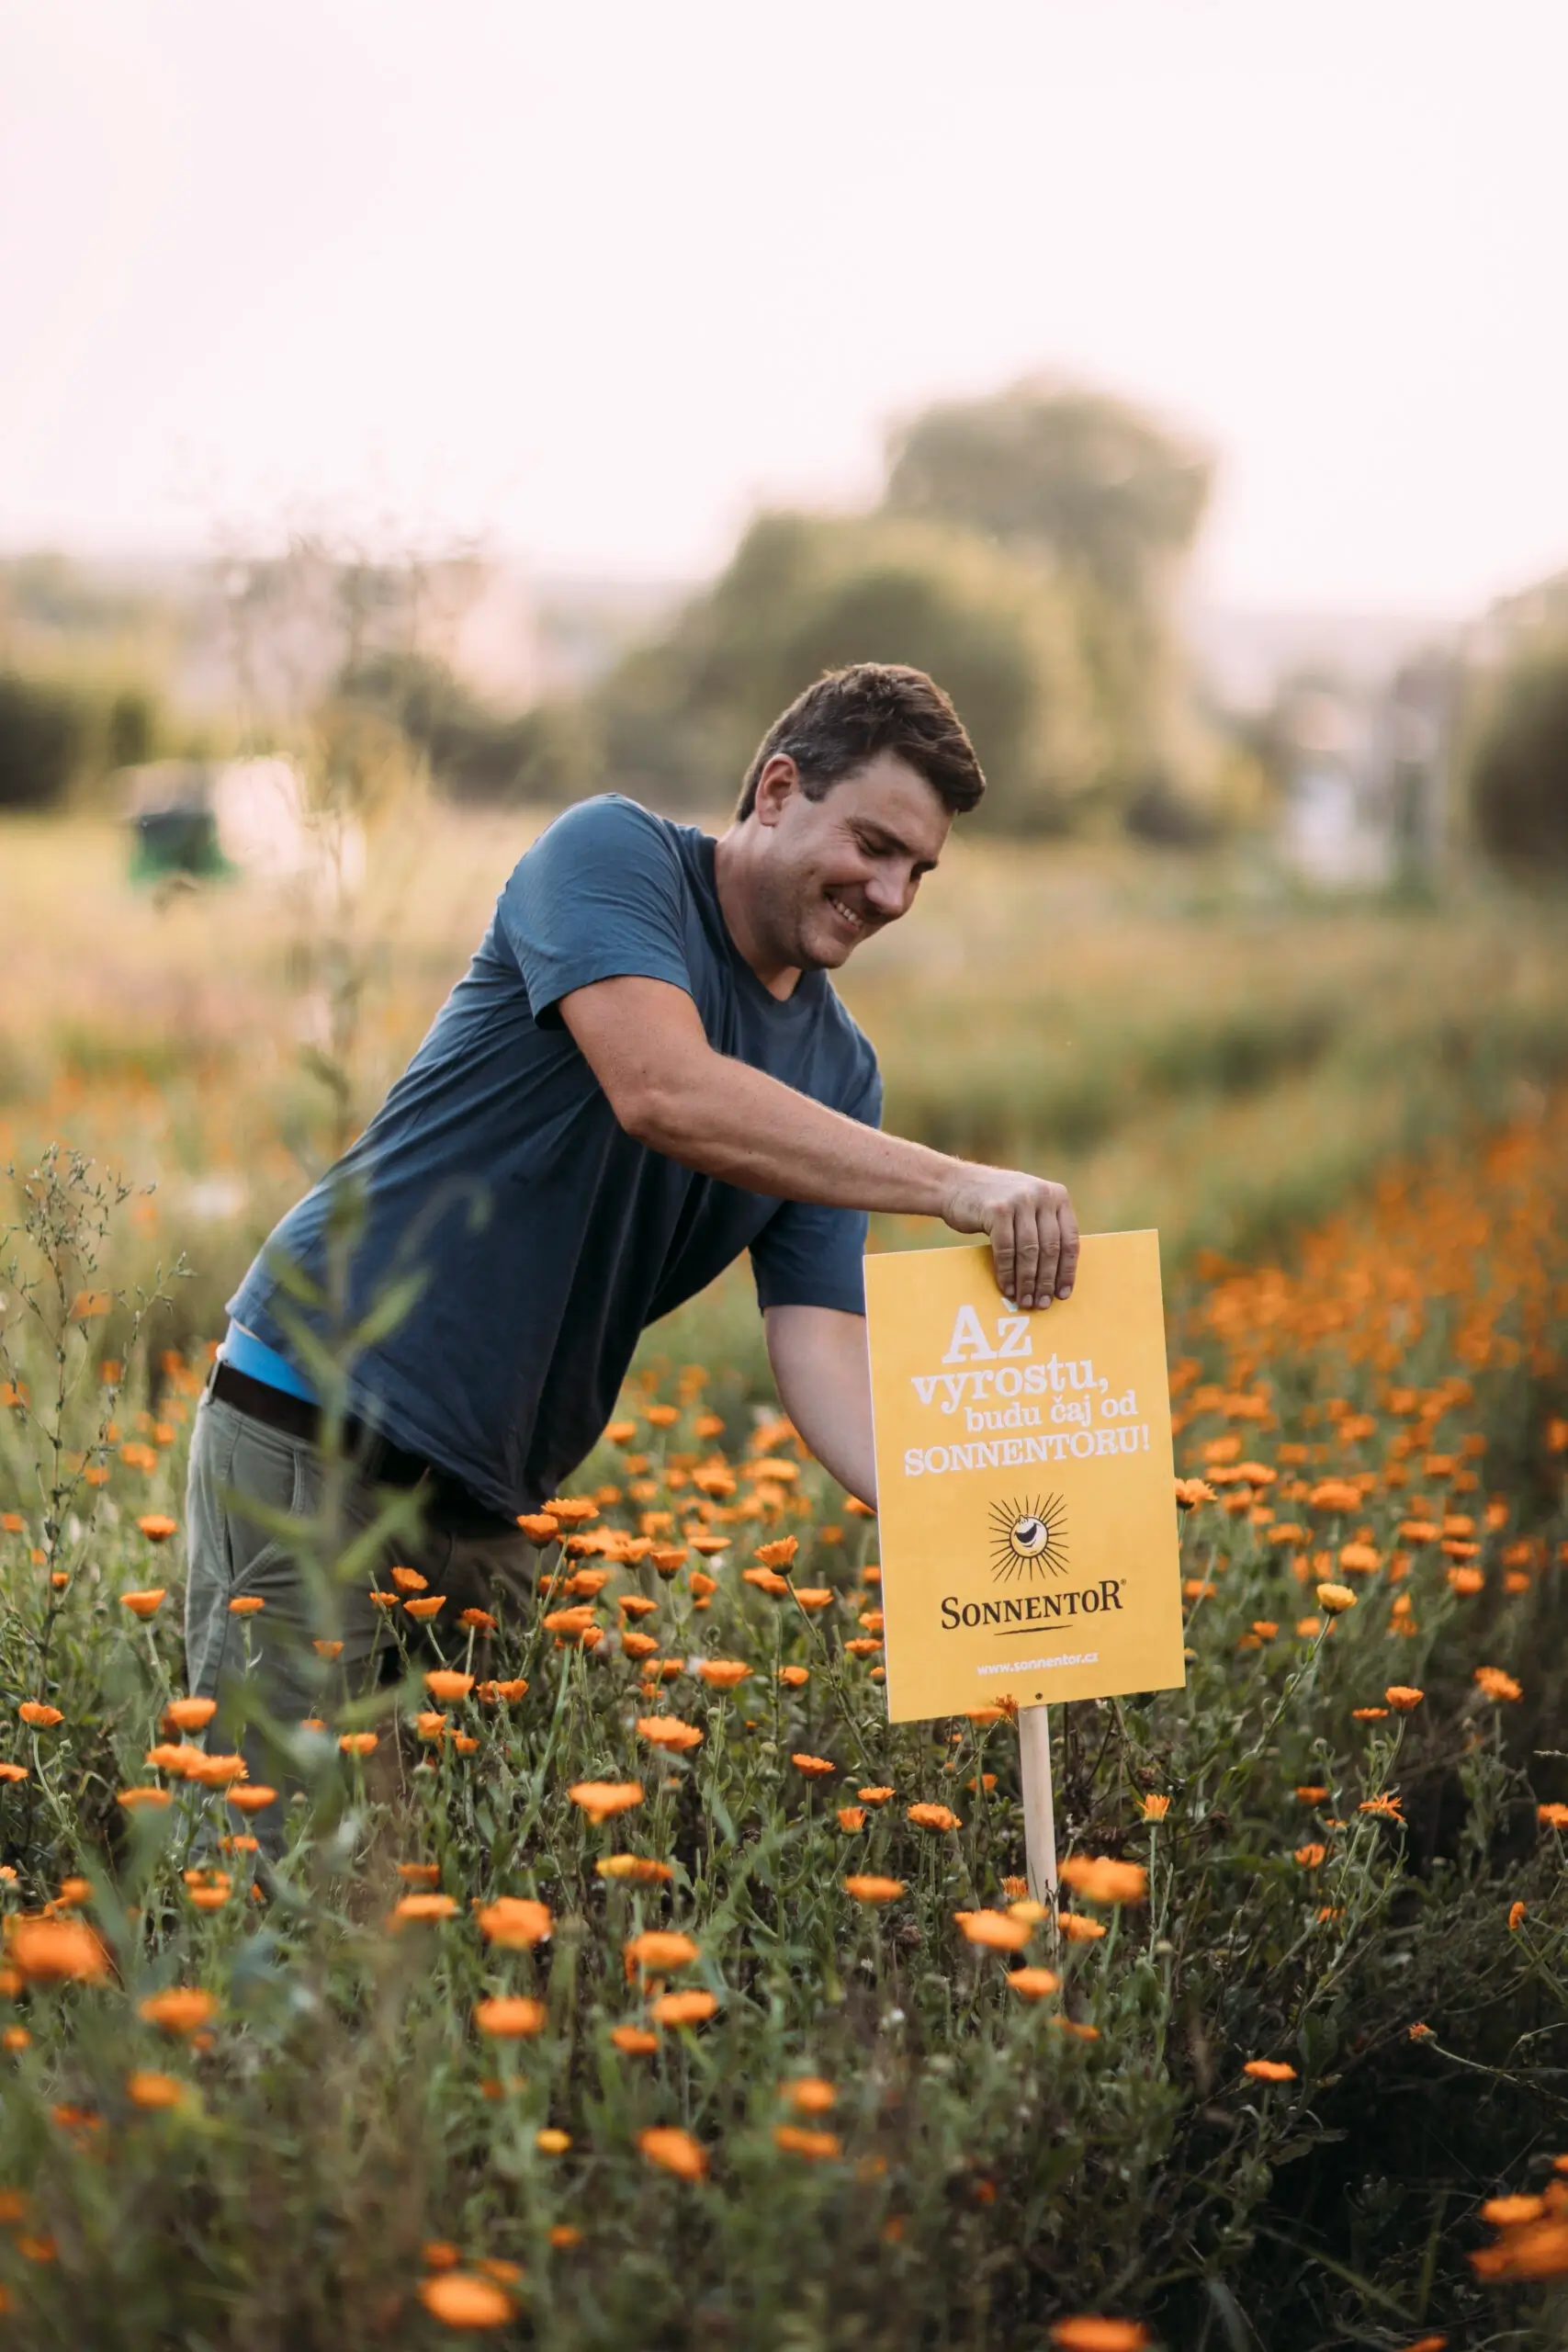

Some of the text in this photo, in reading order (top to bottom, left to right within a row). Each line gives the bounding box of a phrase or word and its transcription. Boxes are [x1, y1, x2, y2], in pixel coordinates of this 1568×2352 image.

[941, 1296, 1032, 1364] Až
[910, 1352, 1109, 1414] vyrostu,
[964, 1389, 1139, 1432] budu čaj od
[904, 1423, 1150, 1476] SONNENTORU!
[976, 1651, 1099, 1676] www.sonnentor.cz
